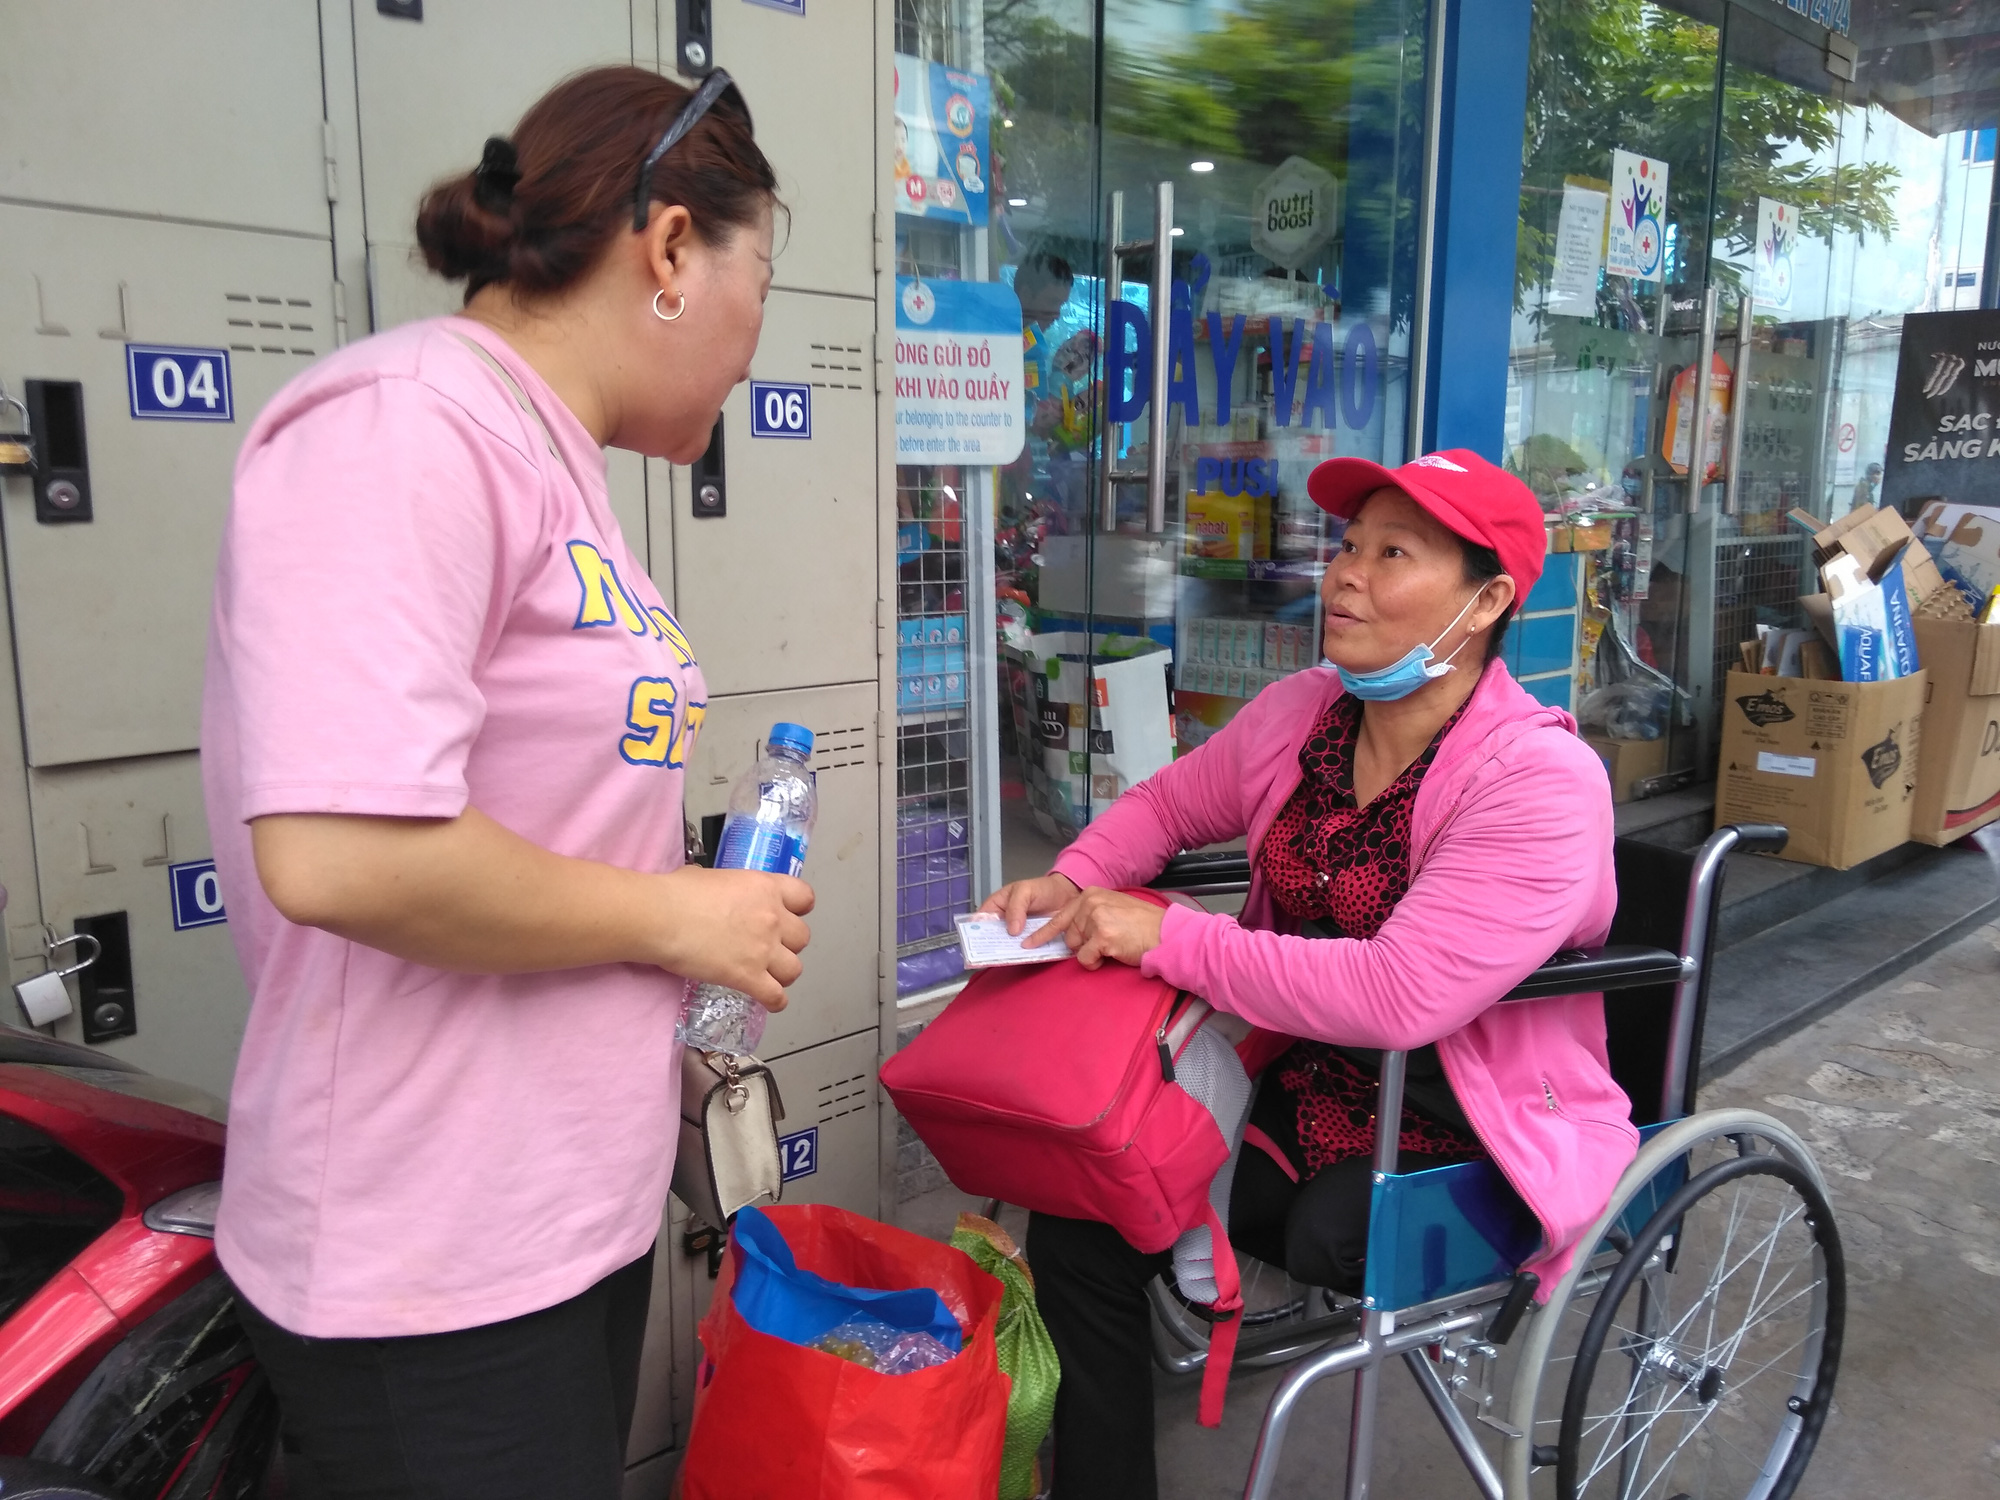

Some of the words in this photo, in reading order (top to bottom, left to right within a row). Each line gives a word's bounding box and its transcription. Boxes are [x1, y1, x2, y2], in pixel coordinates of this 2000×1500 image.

[1268, 189, 1313, 214] nutri
[1268, 208, 1314, 231] boost
[934, 339, 962, 367] GỬI
[967, 339, 991, 368] ĐỒ
[1269, 283, 1378, 430] VÀO
[152, 357, 220, 408] 04
[927, 374, 959, 400] VÀO
[965, 371, 1010, 401] QUẦY
[765, 391, 803, 430] 06
[905, 409, 943, 429] belonging
[945, 411, 954, 426] to
[956, 411, 969, 427] the
[971, 411, 1002, 427] counter
[1004, 412, 1012, 427] to
[1938, 413, 1991, 435] SẠC
[899, 436, 925, 452] before
[926, 437, 946, 453] enter
[947, 437, 960, 453] the
[963, 440, 982, 453] area
[1904, 436, 1983, 462] SẢNG
[781, 1139, 811, 1174] 12
